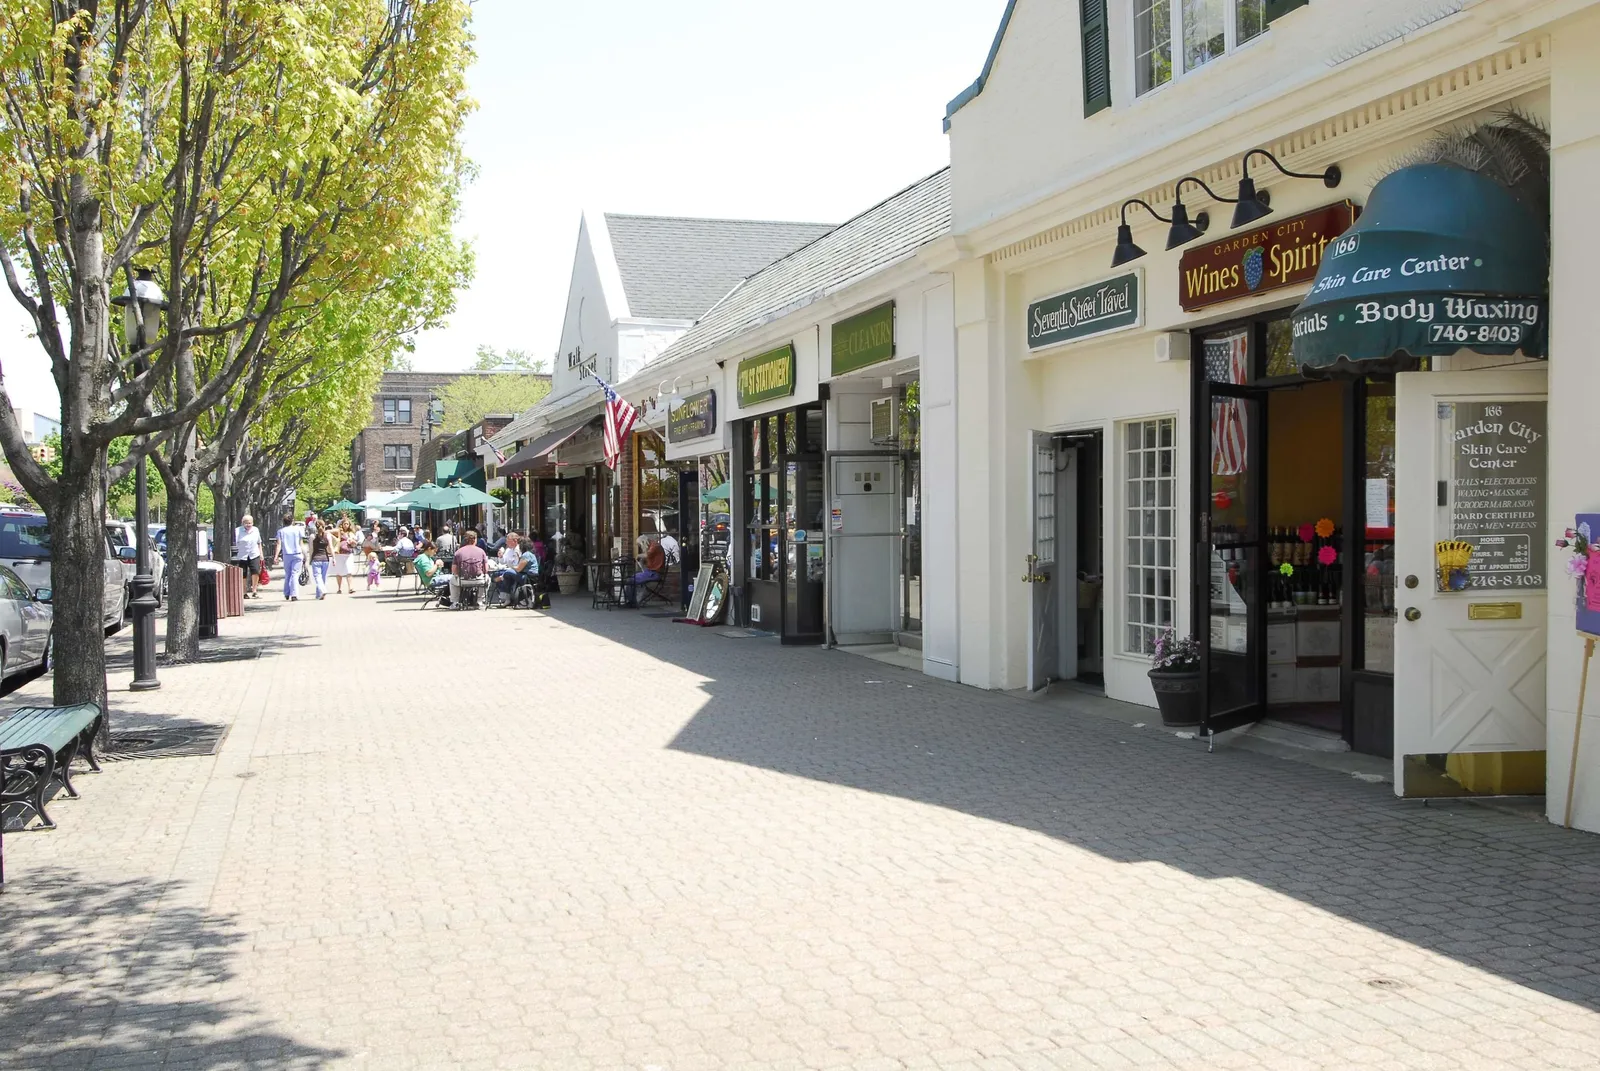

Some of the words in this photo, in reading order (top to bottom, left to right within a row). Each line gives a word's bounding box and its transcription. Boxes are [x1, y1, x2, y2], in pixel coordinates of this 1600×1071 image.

[1214, 231, 1270, 256] GARDEN
[1277, 220, 1307, 237] CITY
[1334, 236, 1357, 257] 166
[1186, 263, 1240, 299] Wines
[1269, 232, 1341, 284] Spirit
[1314, 274, 1347, 294] Skin
[1352, 267, 1392, 284] Care
[1400, 255, 1470, 277] Center
[1031, 301, 1069, 338] Seventh
[1068, 296, 1097, 328] Street
[1097, 282, 1129, 316] Travel
[1355, 299, 1435, 325] Body
[1441, 298, 1540, 326] Waxing
[1432, 325, 1521, 343] 746-8403
[567, 345, 581, 368] Walk
[1484, 405, 1503, 417] 166
[1449, 420, 1504, 442] arden
[1508, 421, 1542, 443] City
[1461, 444, 1493, 456] Skin
[1496, 443, 1527, 454] Care
[1469, 457, 1517, 469] Center
[1483, 476, 1538, 486] ELECTROLYSIS
[1457, 489, 1489, 497] WAXING
[1493, 488, 1530, 497] MASSAGE
[1484, 511, 1535, 520] CERTIFIED
[1484, 522, 1504, 530] MEN
[1509, 521, 1538, 529] TEENS
[1470, 575, 1543, 587] 746-8403
